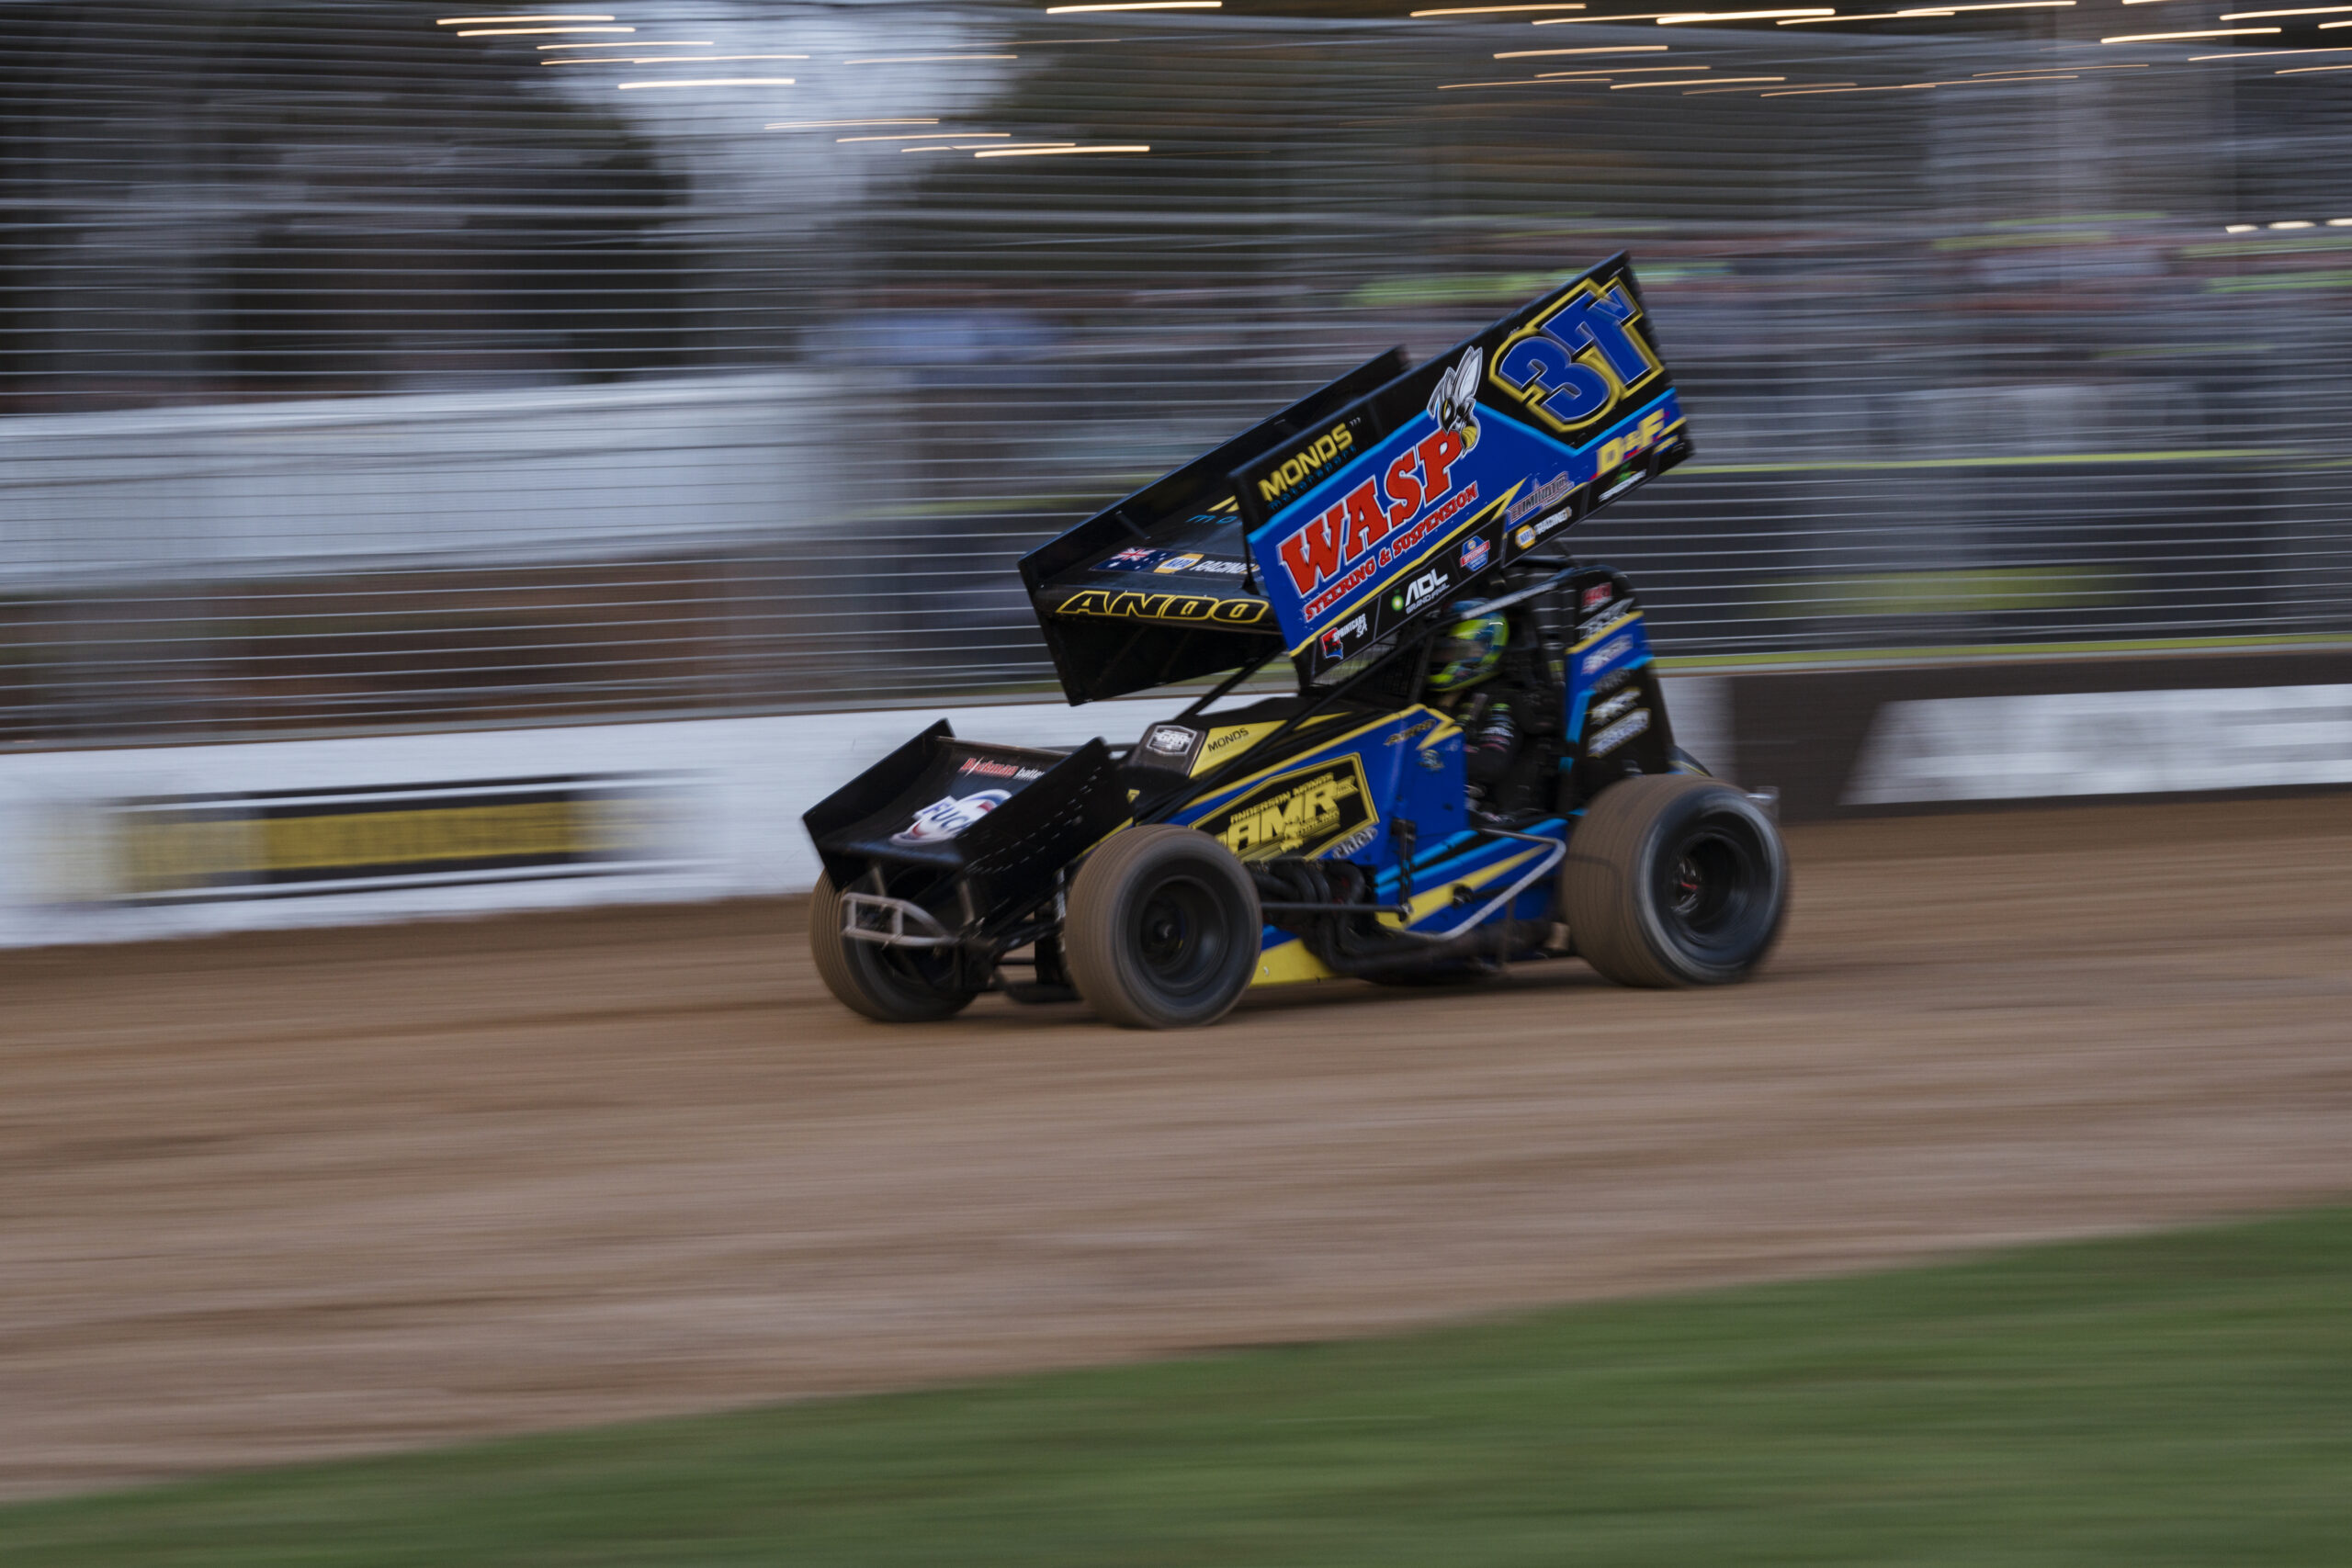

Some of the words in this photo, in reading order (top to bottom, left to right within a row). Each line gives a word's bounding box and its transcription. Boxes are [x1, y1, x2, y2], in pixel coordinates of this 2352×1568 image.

[1258, 423, 1353, 502] MONDS
[1278, 428, 1463, 596] WASP
[1304, 556, 1377, 623] STEERING
[1378, 547, 1393, 569] &
[1391, 481, 1478, 558] SUSPENSION
[1056, 590, 1272, 625] ANDO
[1405, 568, 1449, 607] ADL
[1207, 728, 1250, 751] MONDS
[1227, 781, 1339, 847] AMR
[1230, 791, 1291, 823] ANDERSON
